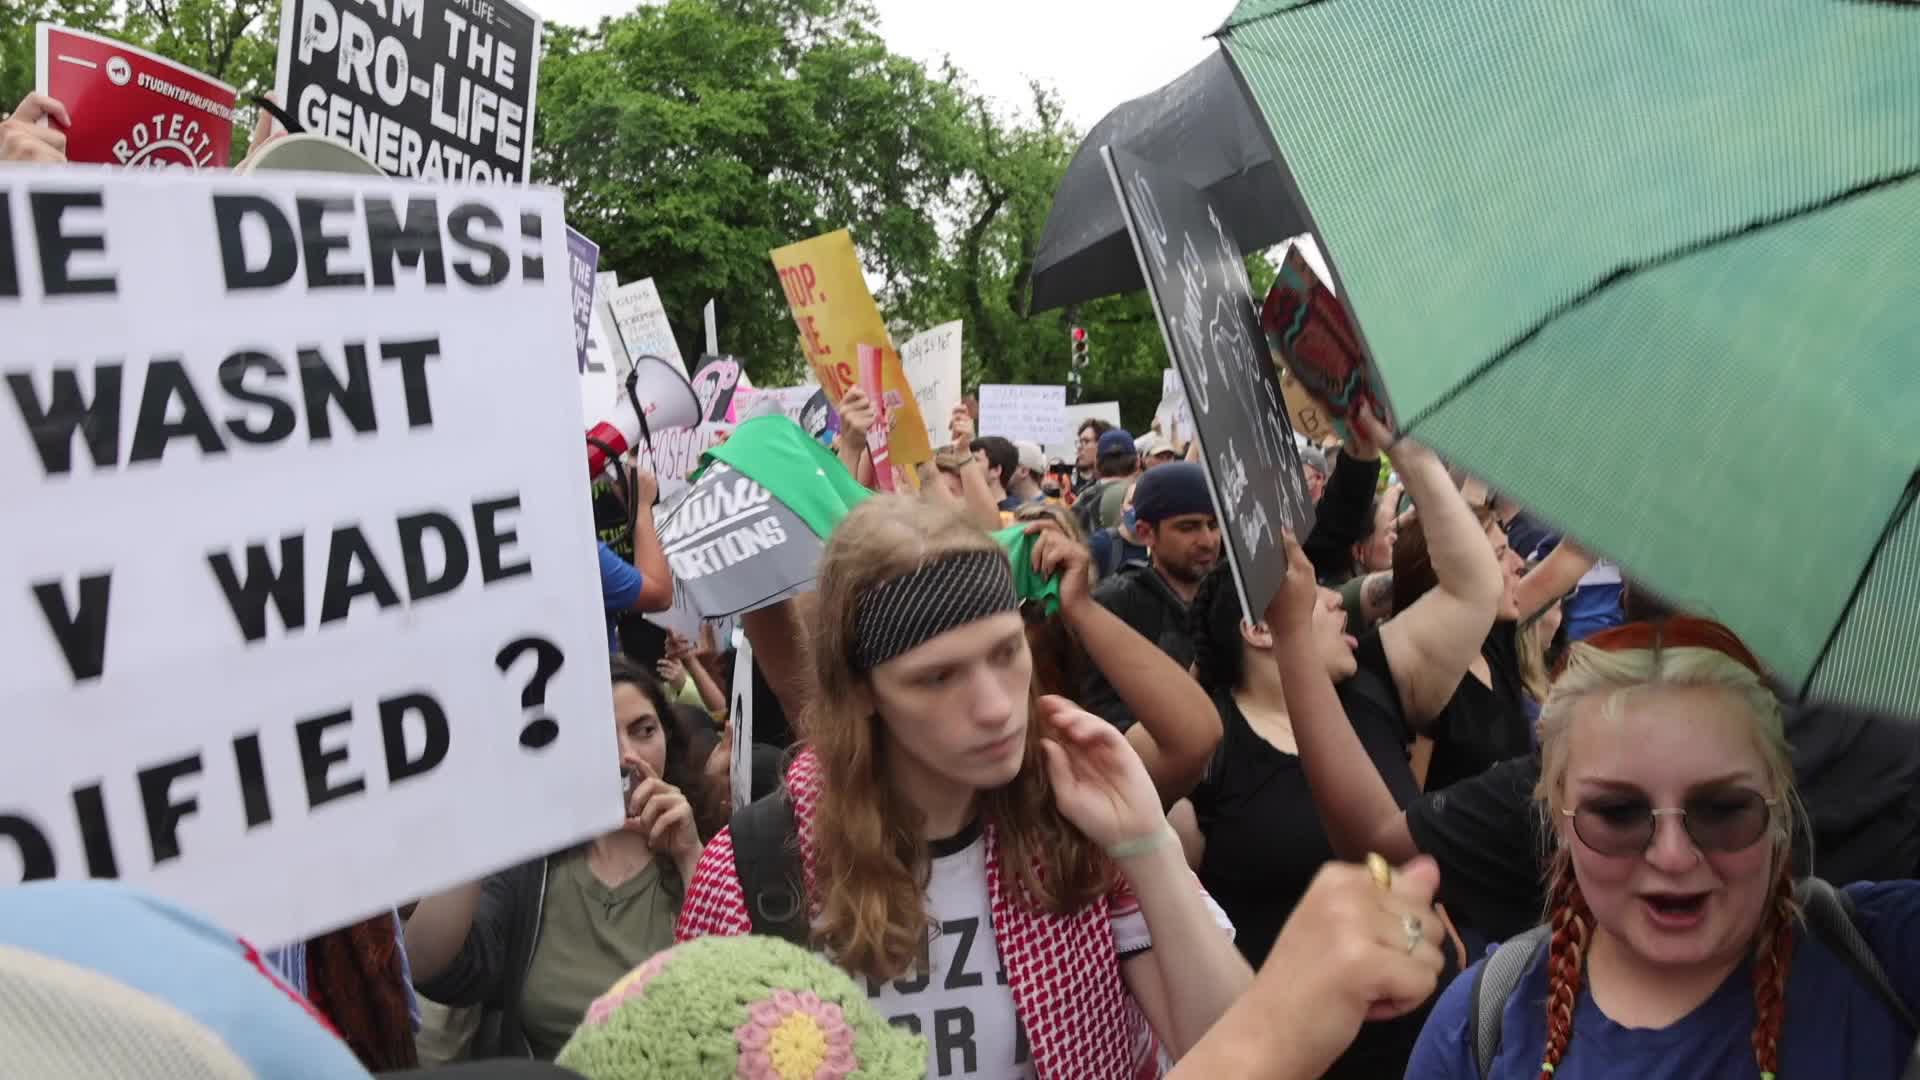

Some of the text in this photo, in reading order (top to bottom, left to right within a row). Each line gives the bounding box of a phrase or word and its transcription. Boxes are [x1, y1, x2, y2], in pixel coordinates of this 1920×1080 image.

[298, 0, 524, 163] PRO-LIFE
[444, 9, 517, 90] THE
[4, 336, 442, 477] WASNT
[31, 496, 534, 686] V WADE
